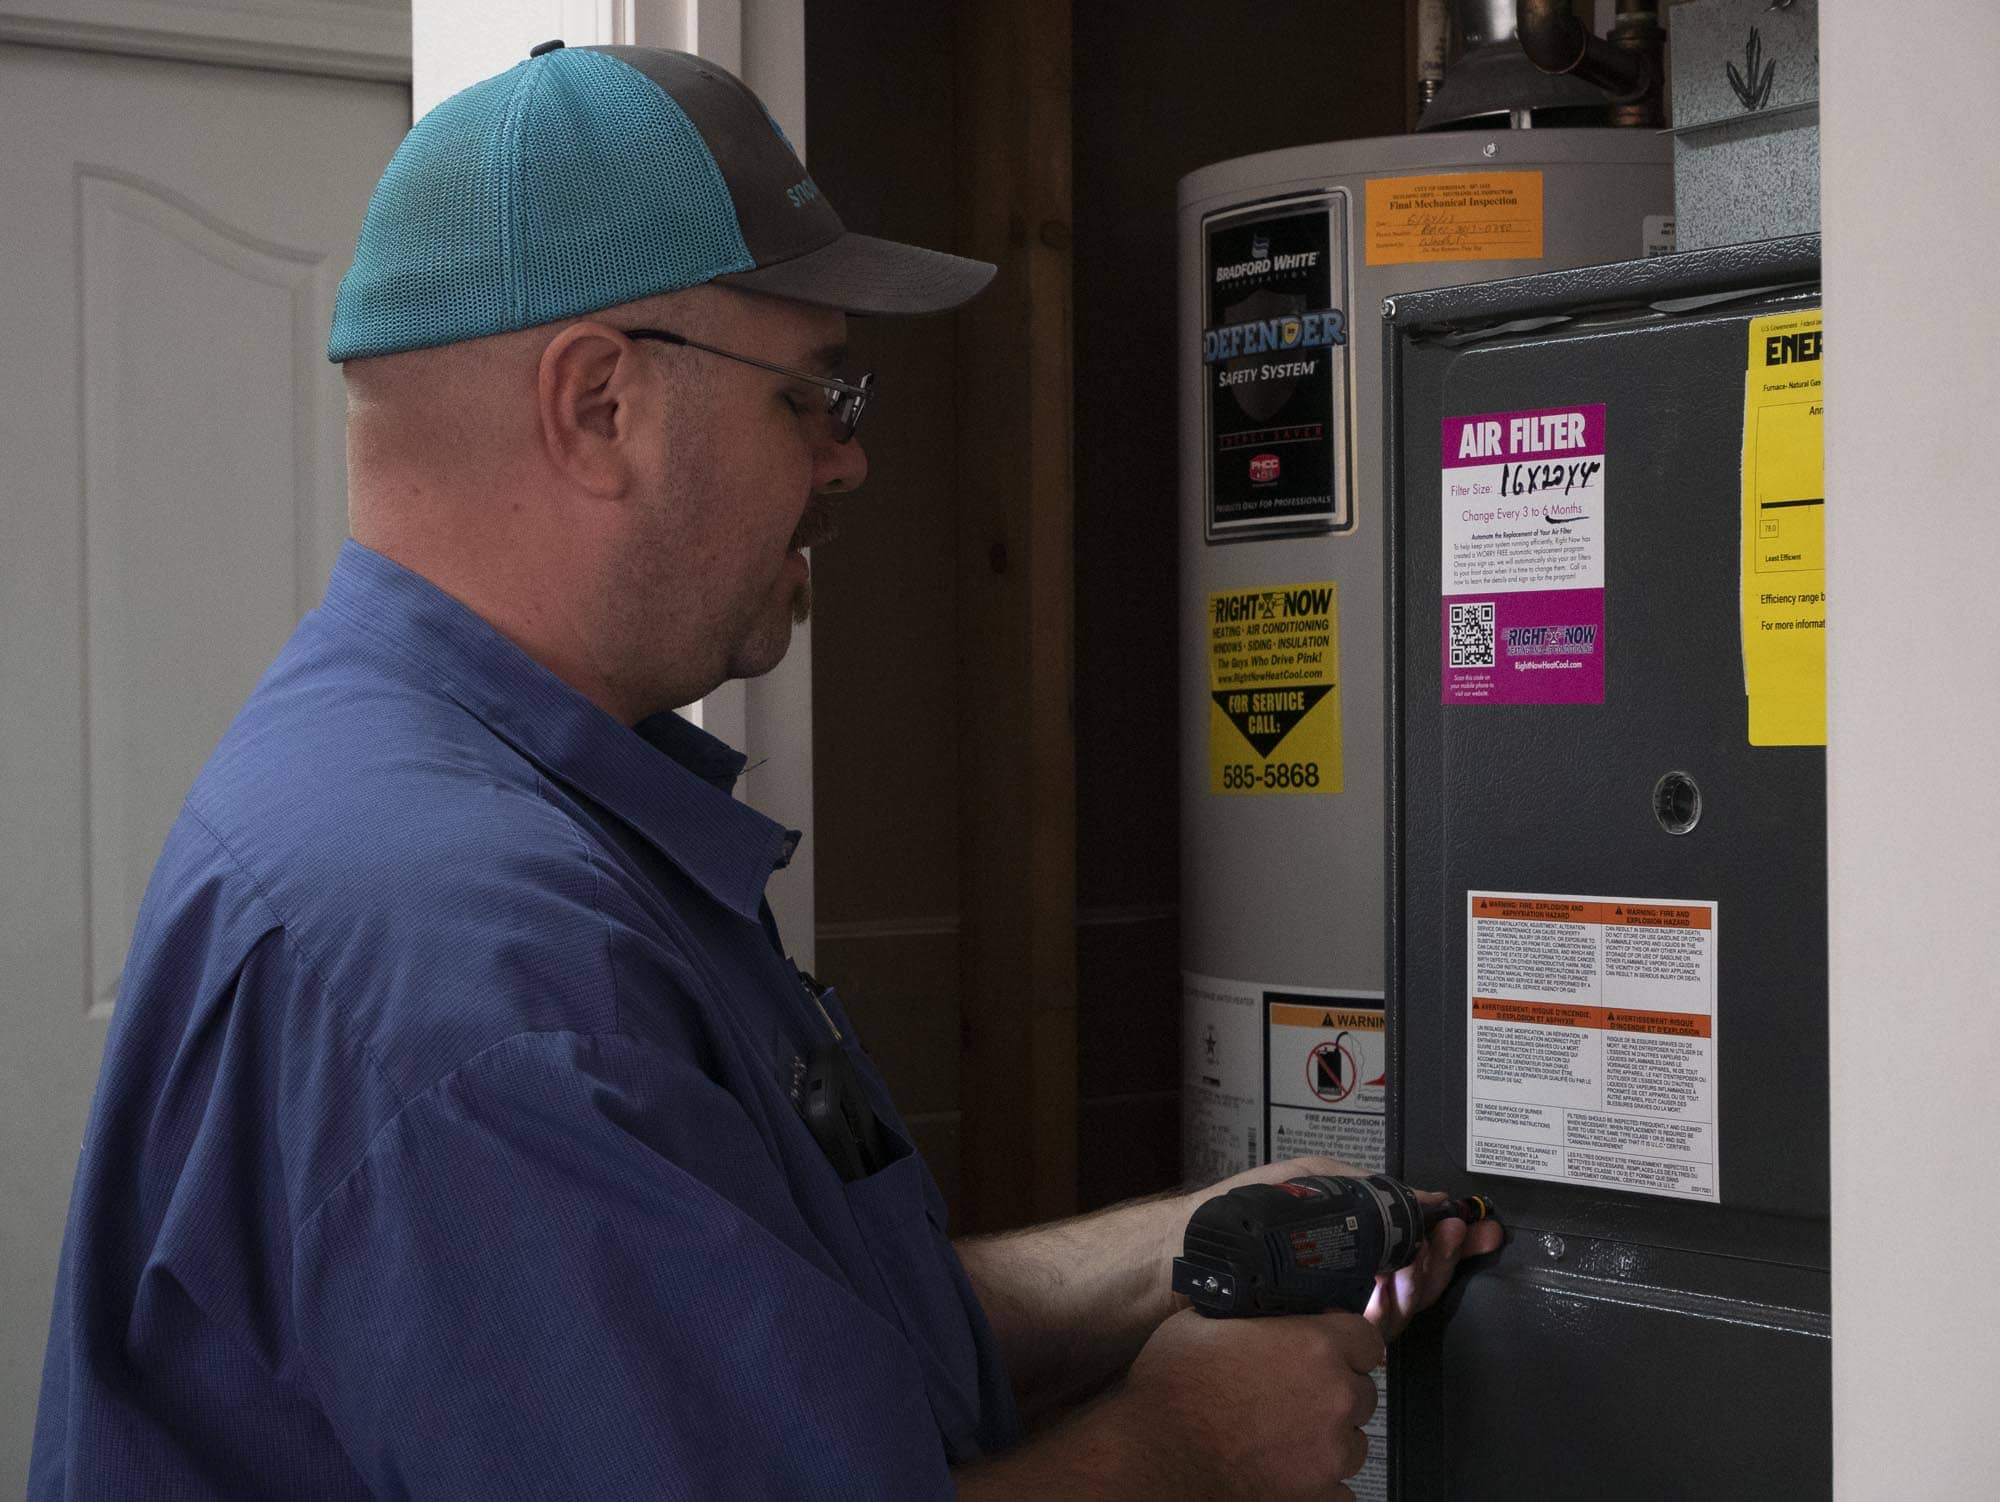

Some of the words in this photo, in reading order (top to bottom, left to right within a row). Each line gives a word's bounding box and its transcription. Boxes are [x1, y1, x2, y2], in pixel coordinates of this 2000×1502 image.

[1390, 200, 1412, 210] Final
[1415, 198, 1466, 209] Mechanical
[1469, 197, 1517, 208] Inspection
[1216, 259, 1271, 282] BRADFORD
[1273, 252, 1317, 271] WHITE
[1204, 311, 1345, 363] DEFENDER
[1219, 368, 1258, 387] SAFETY
[1260, 360, 1316, 380] SYSTEM
[1788, 380, 1810, 388] Natural
[1458, 421, 1502, 458] AIR
[1510, 413, 1586, 454] FILTER
[1250, 460, 1279, 470] PHCC
[1451, 484, 1470, 496] Filter
[1472, 484, 1492, 494] Size:
[1242, 501, 1258, 510] ONLY
[1259, 500, 1272, 509] FOR
[1274, 496, 1331, 508] PROFESSIONALS
[1462, 510, 1494, 523] Change
[1498, 508, 1520, 521] Every
[1523, 507, 1528, 517] 3
[1532, 506, 1540, 517] to
[1542, 506, 1548, 516] 6
[1552, 504, 1582, 515] Months
[1472, 532, 1494, 540] Automate
[1503, 530, 1533, 539] Replacement
[1476, 550, 1496, 558] WORRY
[1766, 554, 1780, 562] Least
[1216, 594, 1260, 622] RIGHT
[1282, 589, 1332, 618] NOW
[1760, 594, 1796, 605] Efficiency
[1798, 594, 1820, 604] range
[1213, 625, 1241, 640] HEATING
[1246, 624, 1260, 636] AIR
[1262, 619, 1329, 635] CONDITIONING
[1762, 620, 1774, 631] For
[1775, 622, 1794, 630] more
[1508, 628, 1547, 646] RIGHT
[1564, 626, 1596, 644] NOW
[1214, 641, 1242, 654] WINDOWS
[1248, 640, 1272, 650] SIDING
[1278, 636, 1330, 650] INSULATION
[1218, 658, 1229, 668] The
[1232, 658, 1248, 670] Guys
[1252, 656, 1268, 667] Who
[1272, 654, 1294, 666] Drive
[1296, 652, 1322, 664] Pink!
[1515, 660, 1582, 672] RightNowHeatCool.com
[1218, 670, 1323, 684] www.RightNowHeatCool.com
[1228, 694, 1248, 714] FOR
[1252, 692, 1304, 713] SERVICE
[1248, 715, 1281, 734] CALL:
[1223, 762, 1320, 789] 585-5868
[1546, 912, 1570, 920] HAZARD
[1664, 918, 1690, 926] HAZARD
[1305, 1114, 1320, 1122] FIRE
[1322, 1115, 1336, 1124] AND
[1338, 1116, 1380, 1127] EXPLOSION
